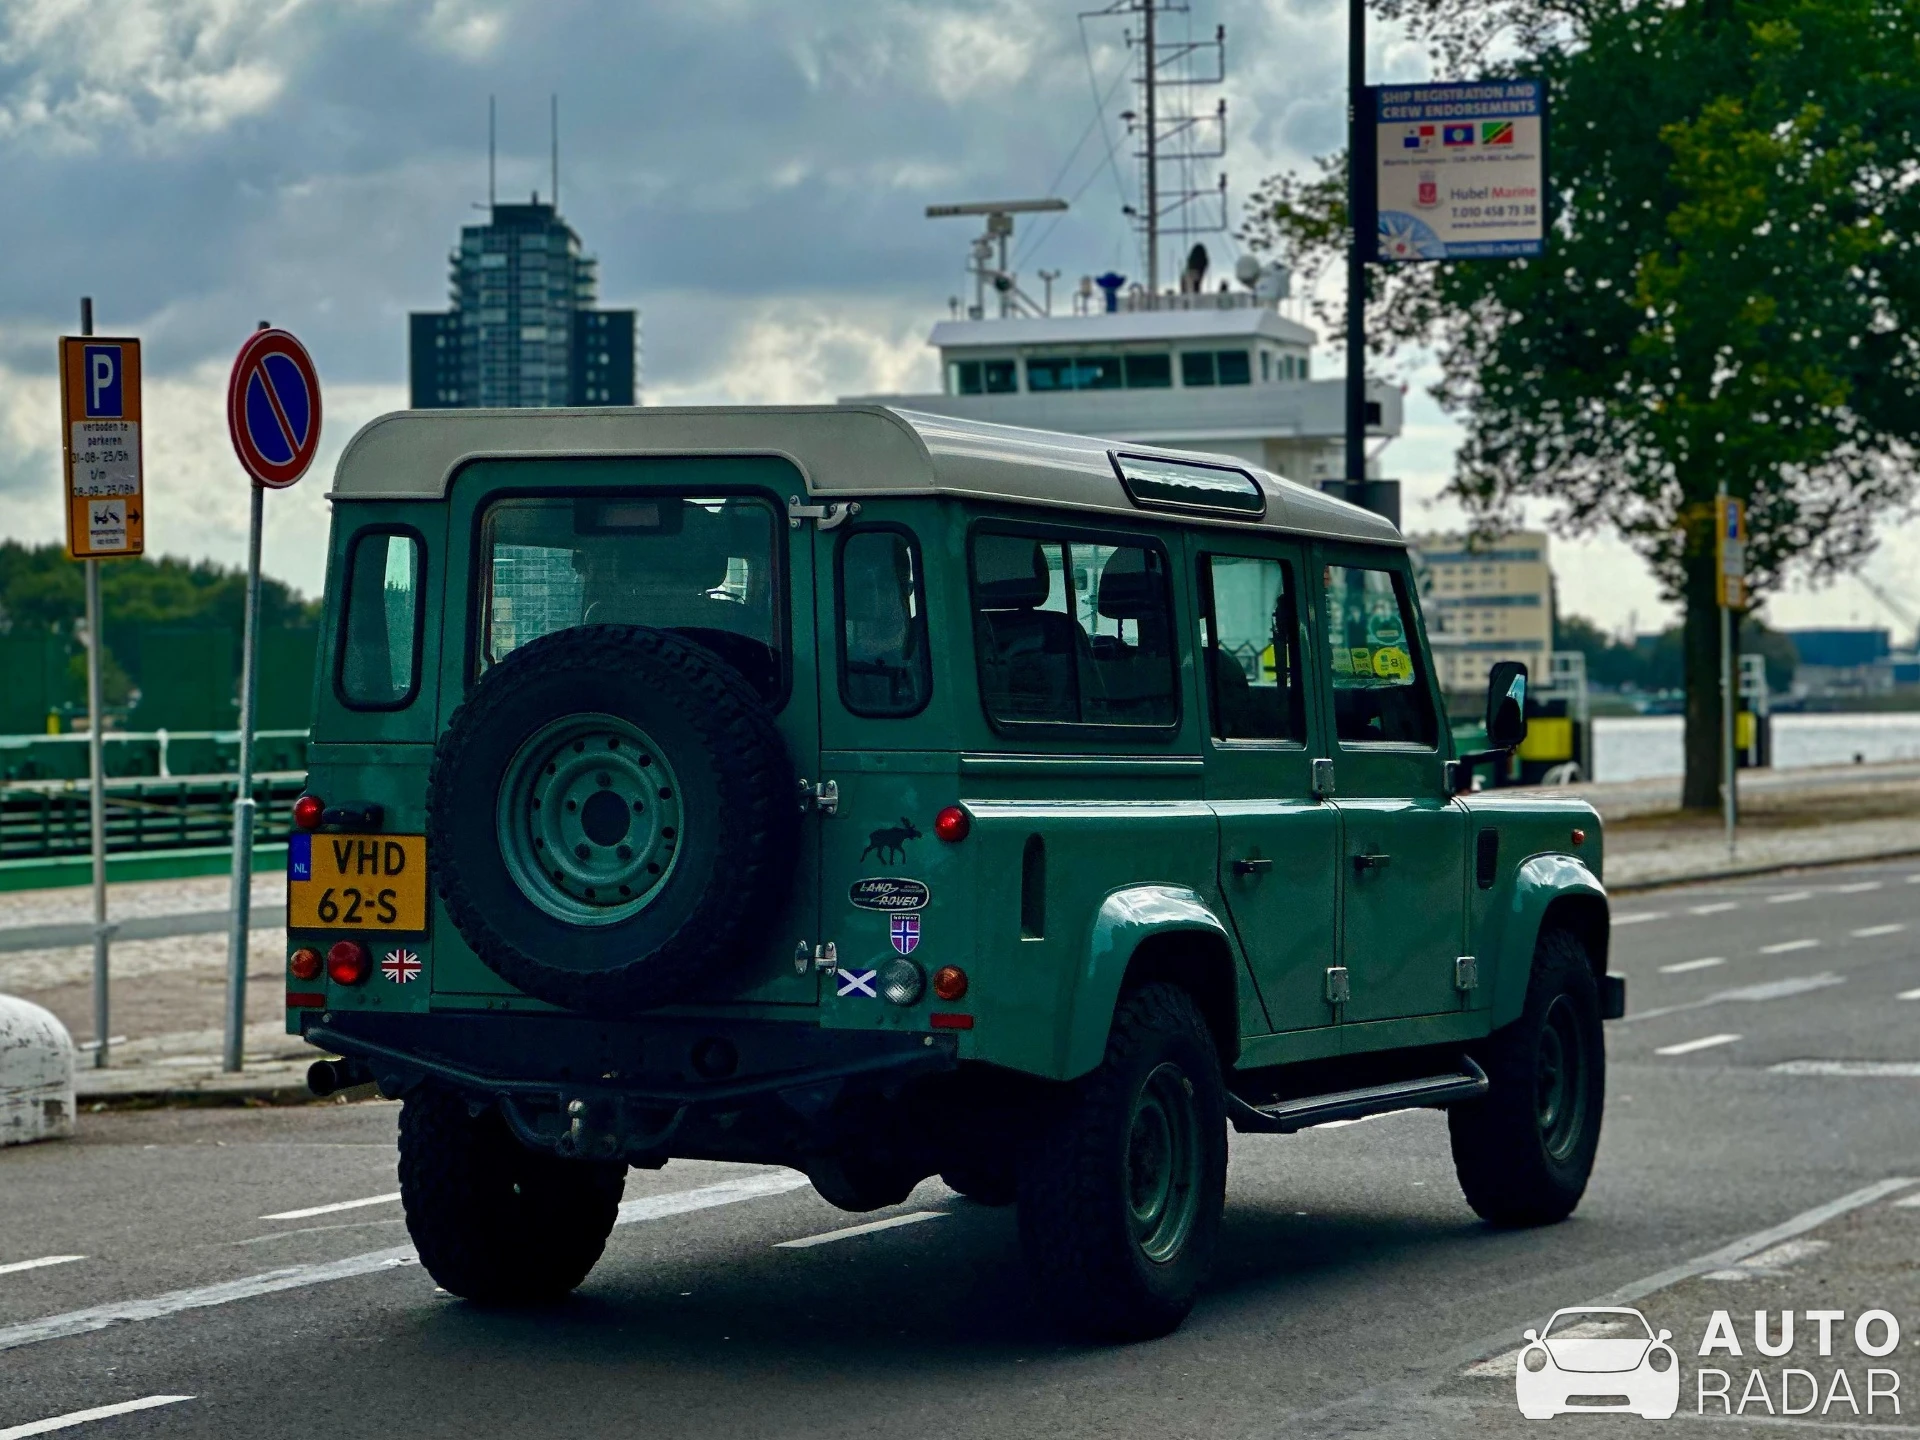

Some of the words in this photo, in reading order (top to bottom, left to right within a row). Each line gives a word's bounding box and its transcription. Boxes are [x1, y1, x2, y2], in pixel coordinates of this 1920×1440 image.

[1382, 92, 1411, 103] SHIP
[1414, 87, 1502, 101] REGISTRATION
[1507, 85, 1535, 97] AND
[1382, 106, 1420, 118] CREW
[1425, 101, 1535, 116] ENDORSEMENTS
[1451, 188, 1488, 199] Hubel
[1492, 186, 1536, 198] Marine
[1484, 207, 1504, 216] 458
[1524, 205, 1535, 215] 38
[92, 354, 114, 409] P
[83, 423, 118, 432] verboden
[88, 436, 122, 447] parkeren
[333, 840, 405, 876] VHD
[294, 864, 308, 874] NL
[860, 883, 892, 892] LAND
[318, 888, 397, 924] 62-S
[879, 896, 919, 906] ROVER
